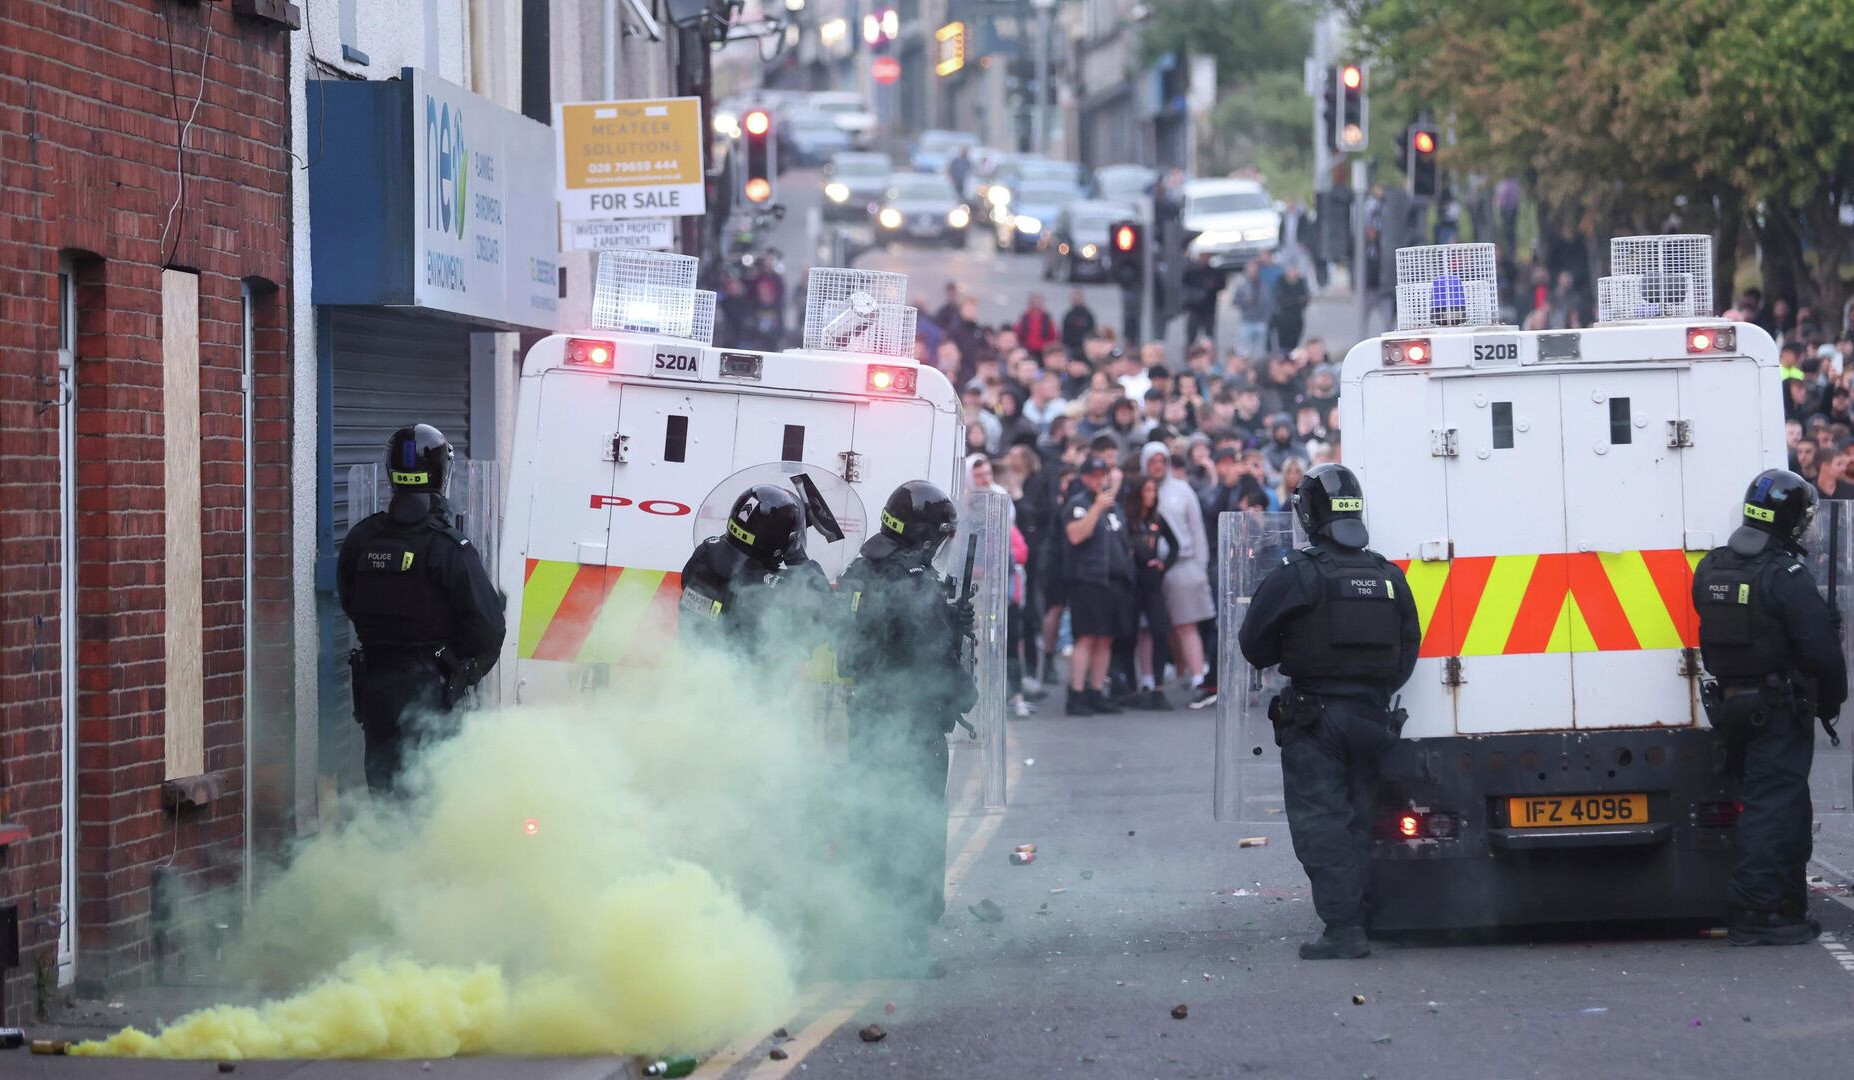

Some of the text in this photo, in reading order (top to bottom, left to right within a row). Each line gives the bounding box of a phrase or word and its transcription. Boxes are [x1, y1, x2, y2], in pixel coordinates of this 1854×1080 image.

[583, 140, 682, 157] SOLUTIONS
[655, 159, 678, 170] 444
[590, 190, 680, 211] FOR SALE
[626, 222, 667, 234] PROPERTY
[1474, 344, 1518, 360] S20B
[655, 353, 697, 372] S20A
[367, 553, 392, 561] POLICE
[1525, 798, 1633, 823] IFZ 4096
